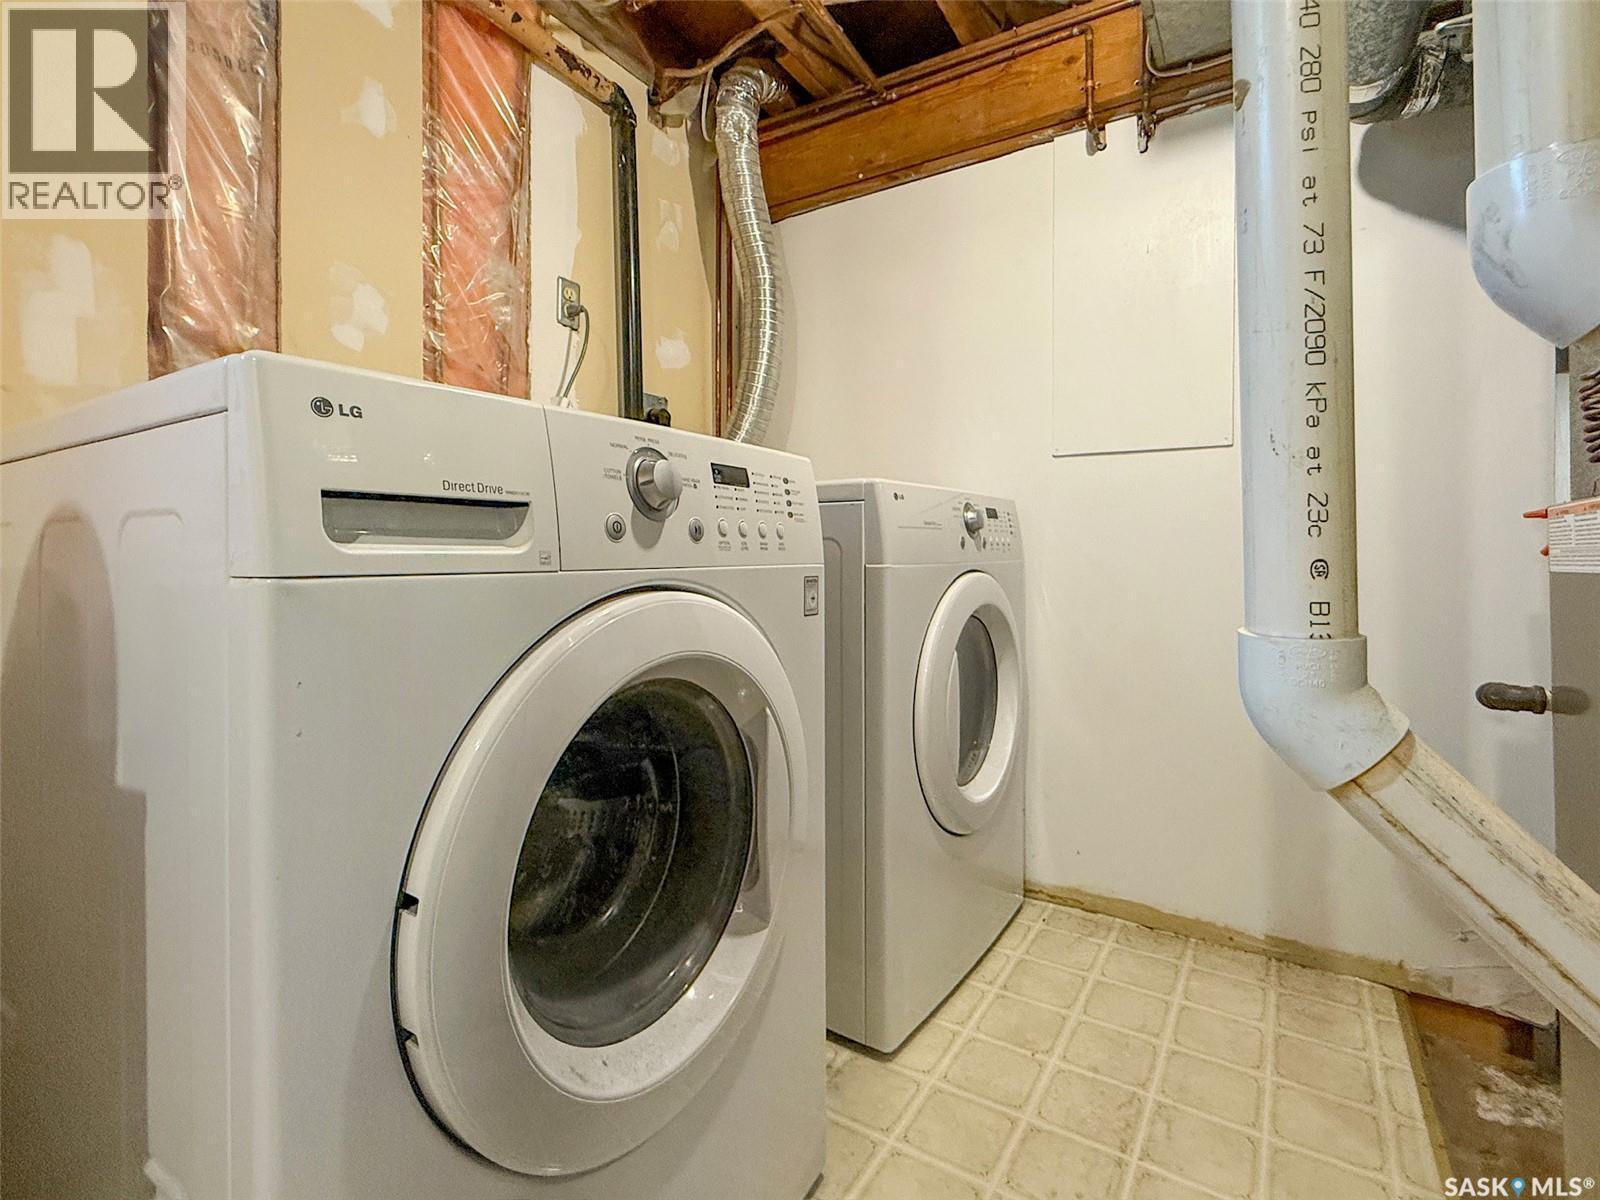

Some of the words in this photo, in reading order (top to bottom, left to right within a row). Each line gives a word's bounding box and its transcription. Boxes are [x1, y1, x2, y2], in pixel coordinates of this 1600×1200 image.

[1299, 44, 1322, 94] 280
[1302, 176, 1318, 207] at
[1303, 222, 1325, 255] 73
[1304, 270, 1327, 366] F/2090
[338, 403, 363, 419] LG
[1305, 382, 1328, 428] kPa
[1306, 446, 1322, 476] at
[442, 479, 475, 493] Direct
[476, 482, 504, 495] Drive
